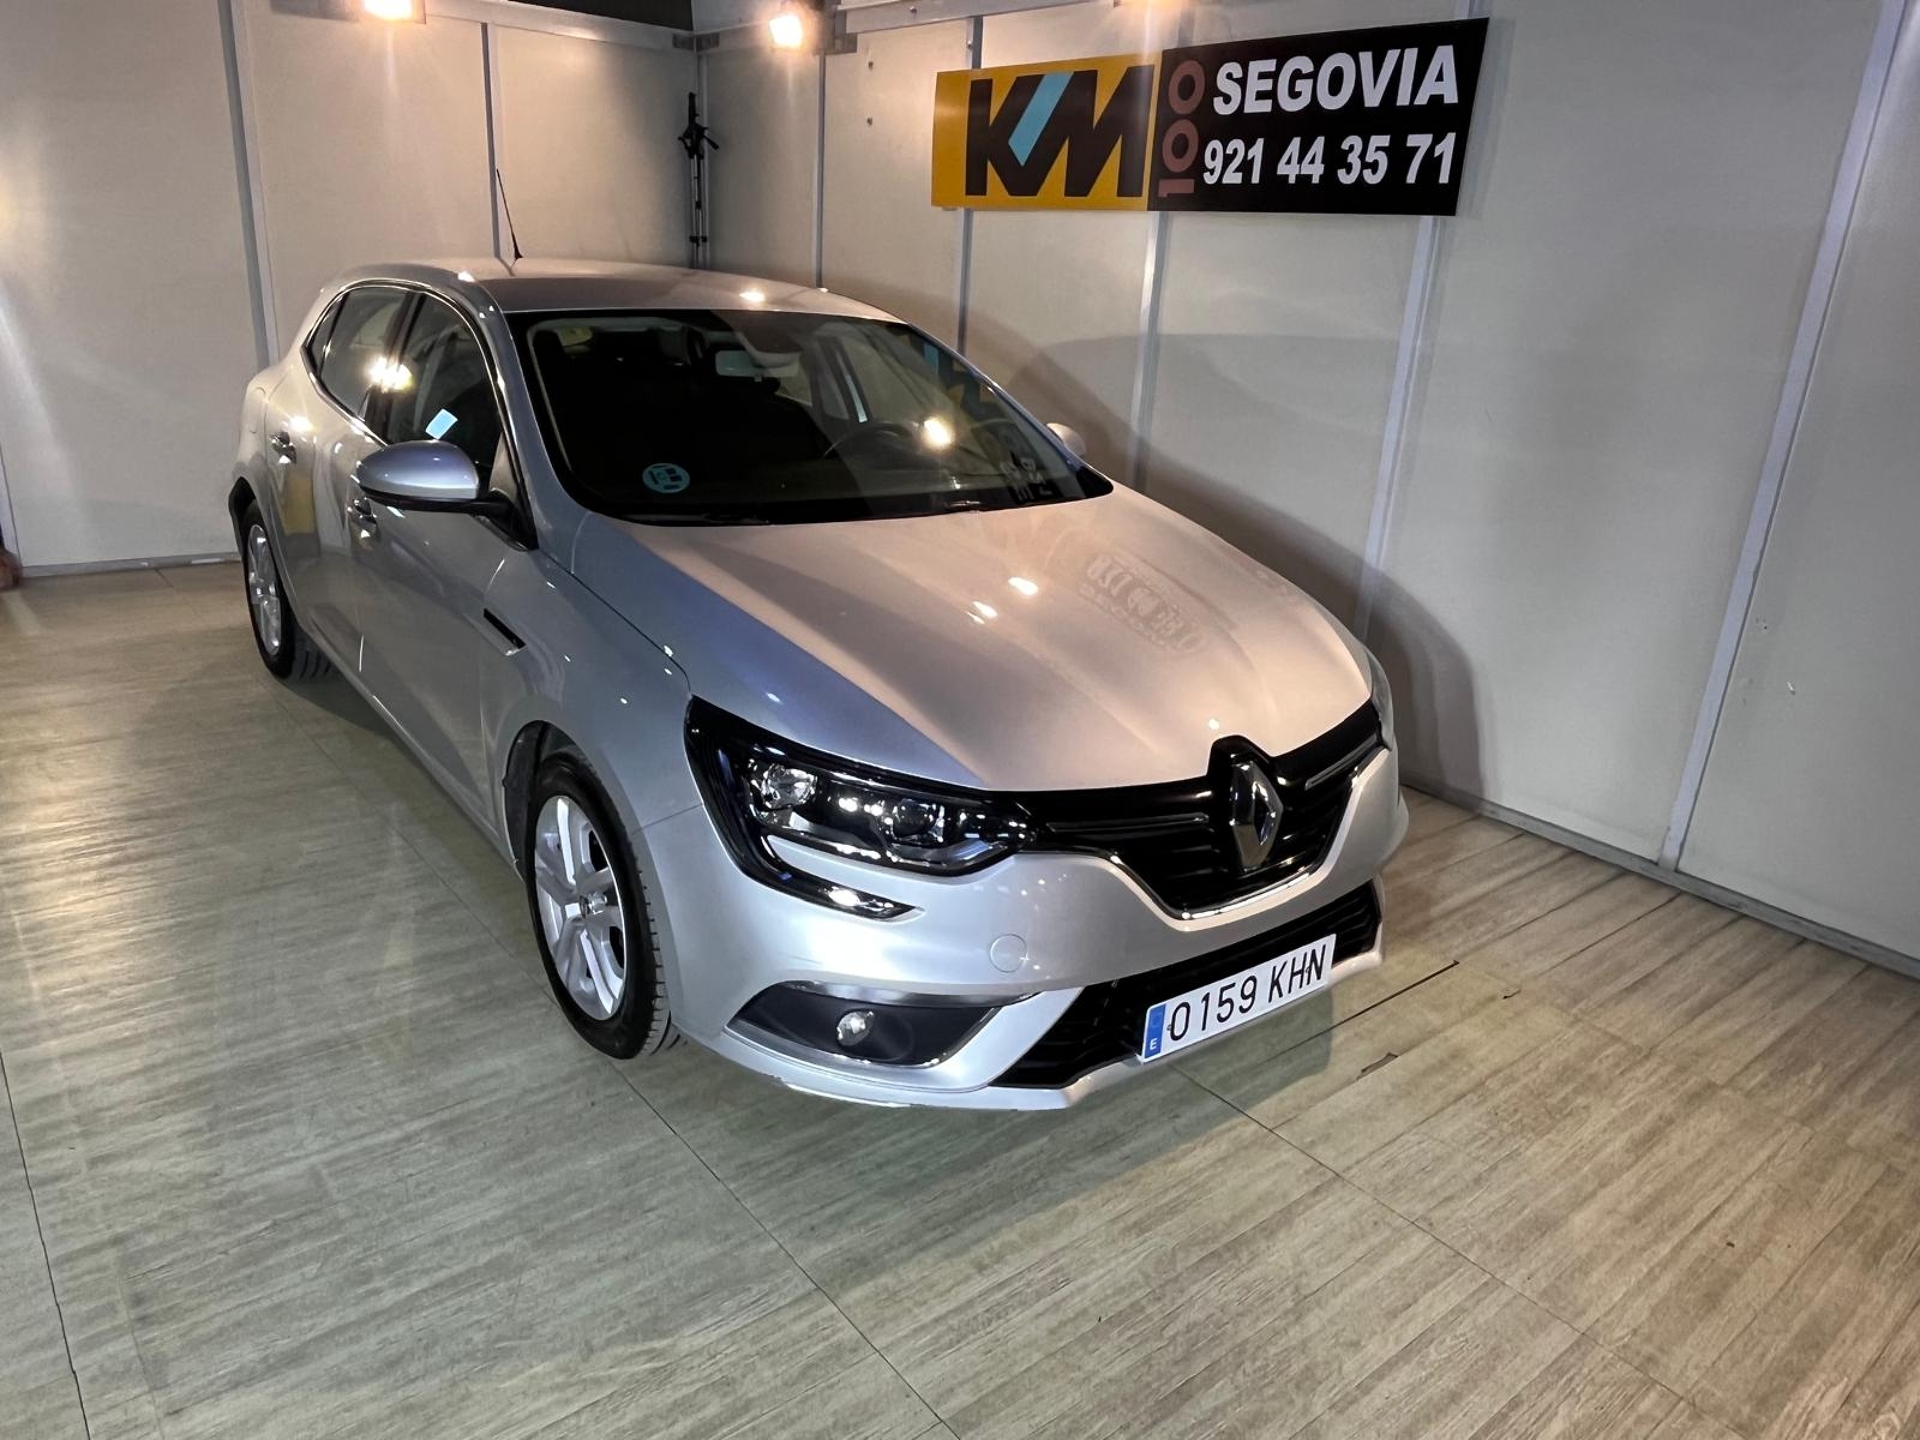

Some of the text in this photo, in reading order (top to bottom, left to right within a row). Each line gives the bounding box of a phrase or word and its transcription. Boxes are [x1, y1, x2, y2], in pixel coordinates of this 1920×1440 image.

[1213, 45, 1459, 115] SEGOVIA
[965, 64, 1156, 197] KM
[1159, 60, 1205, 197] 100
[1203, 132, 1457, 185] 921 44 35 71
[1169, 945, 1326, 1041] 0159 KHN
[1150, 1038, 1158, 1050] E
